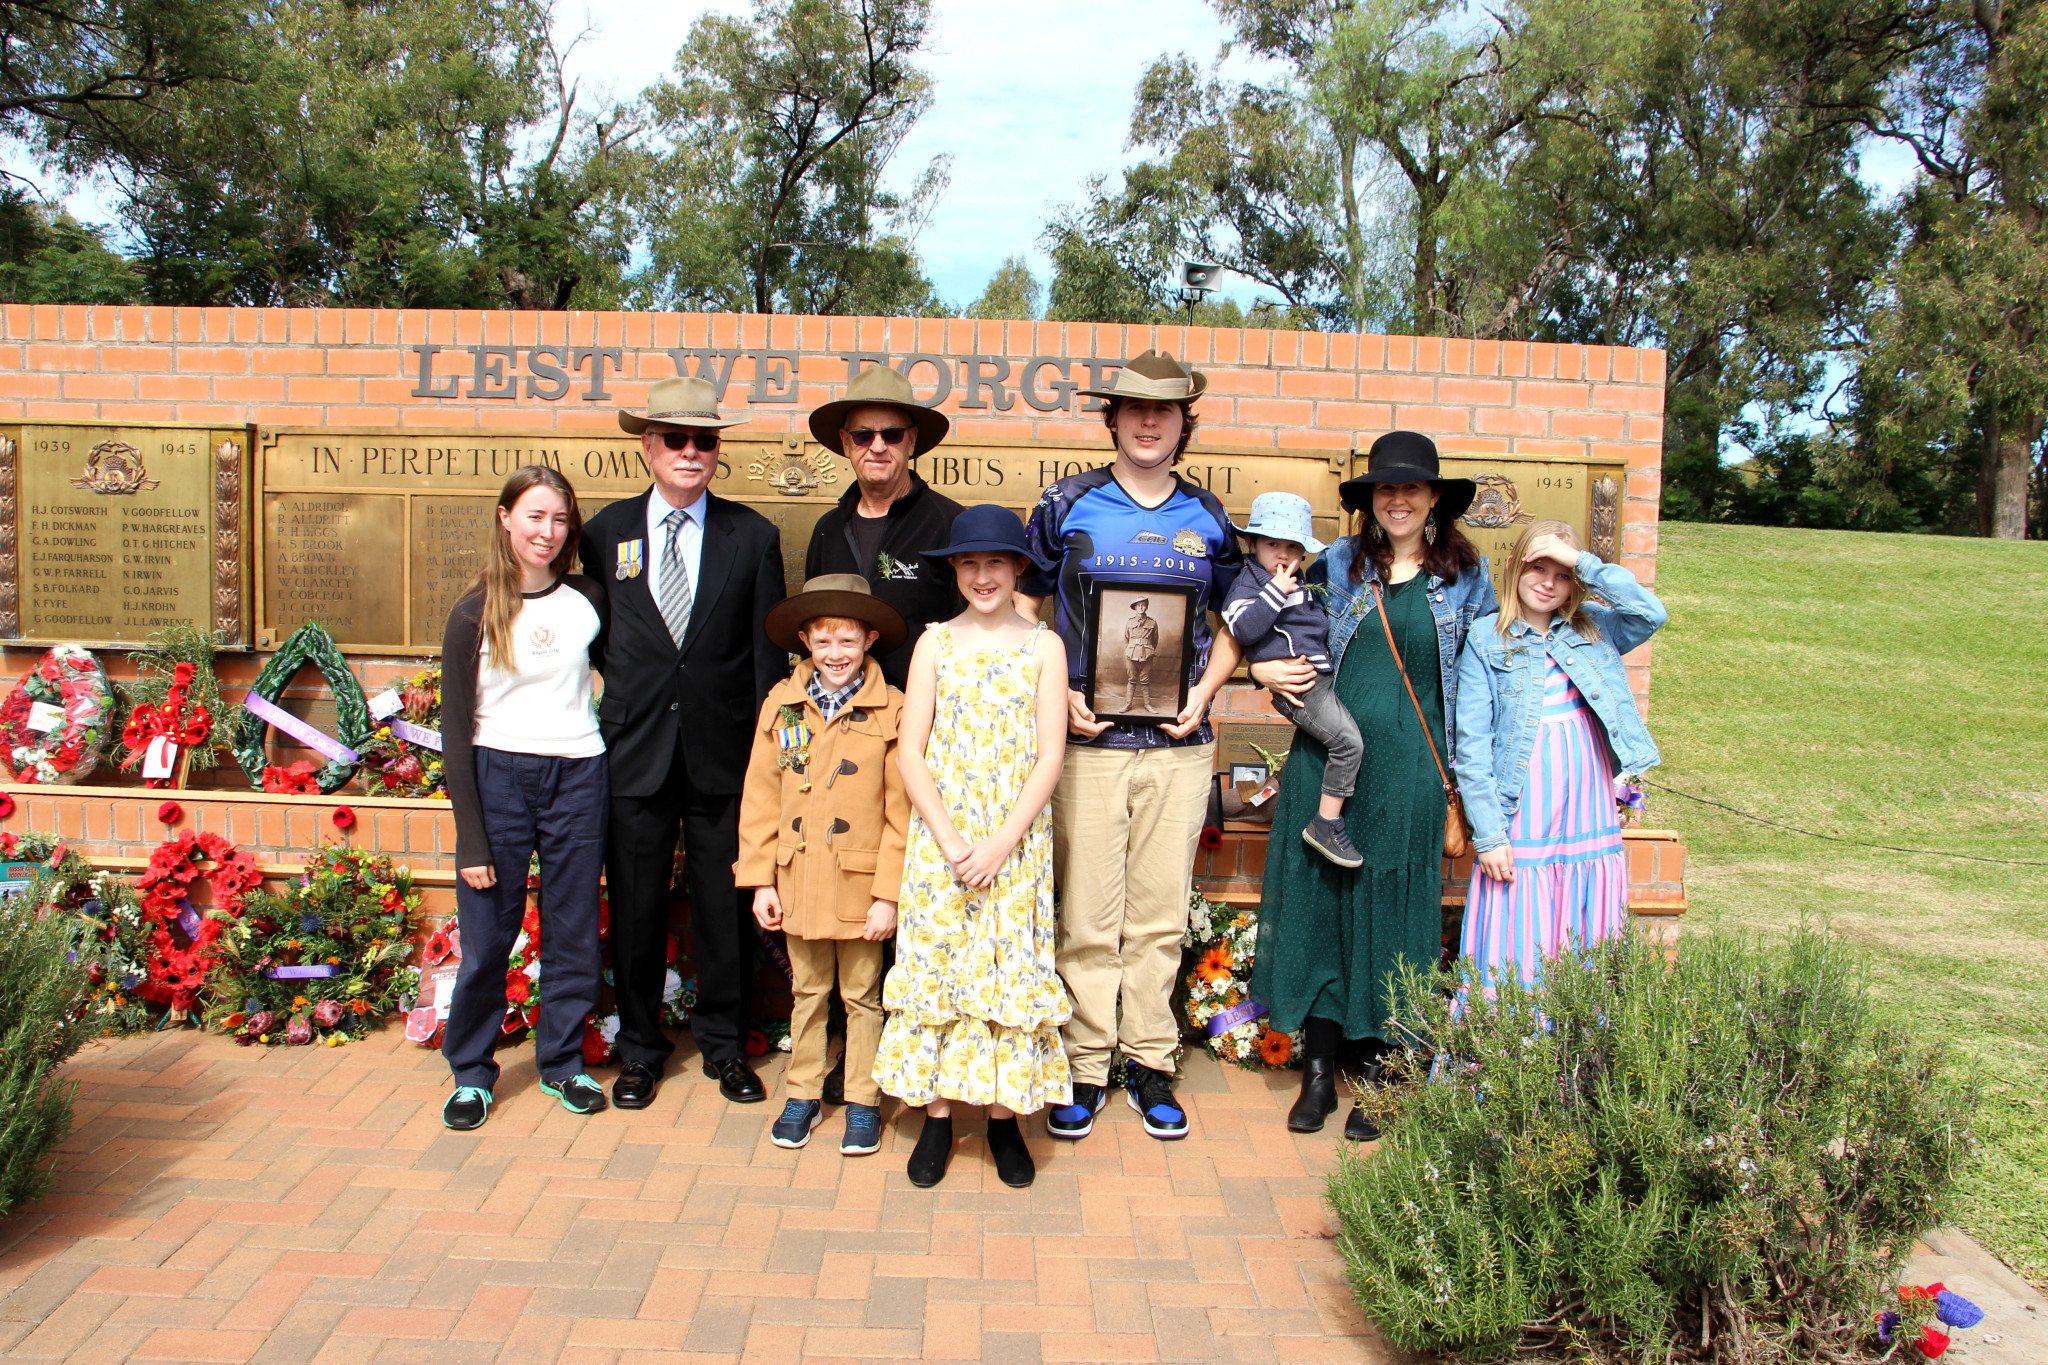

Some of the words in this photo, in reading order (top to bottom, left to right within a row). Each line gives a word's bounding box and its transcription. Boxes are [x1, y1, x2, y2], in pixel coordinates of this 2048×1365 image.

[411, 345, 622, 400] LEST
[667, 348, 799, 403] WE
[841, 353, 1192, 412] FORGE
[34, 441, 70, 453] 1939
[161, 443, 196, 455] 1945
[312, 447, 342, 473] IN
[362, 448, 561, 476] PERPETUUM
[584, 450, 731, 480] OMNS
[747, 445, 775, 481] 1914
[811, 446, 838, 484] 1919
[1536, 477, 1574, 490] 1945
[50, 506, 108, 516] COTSWORTH
[131, 508, 200, 518] GOODFELLOW
[53, 522, 97, 531] DICKMAN
[142, 524, 206, 534] HARGREAVES
[52, 537, 97, 547] DOWLING
[152, 539, 196, 549] HITCHEN
[47, 552, 114, 563] FARQUHARSON
[144, 555, 172, 564] IRVIN
[63, 568, 107, 579] FARRELL
[133, 570, 163, 580] IRWIN
[52, 584, 101, 594] FOLKARD
[142, 587, 180, 596] JARVIS
[43, 599, 69, 609] FYFE
[141, 602, 177, 612] KROHN
[44, 615, 113, 625] GOODFELLOW
[265, 708, 290, 727] LEST
[289, 721, 307, 737] WE
[306, 731, 345, 758] FORGET
[411, 726, 432, 744] WE
[1223, 1003, 1255, 1026] LEST
